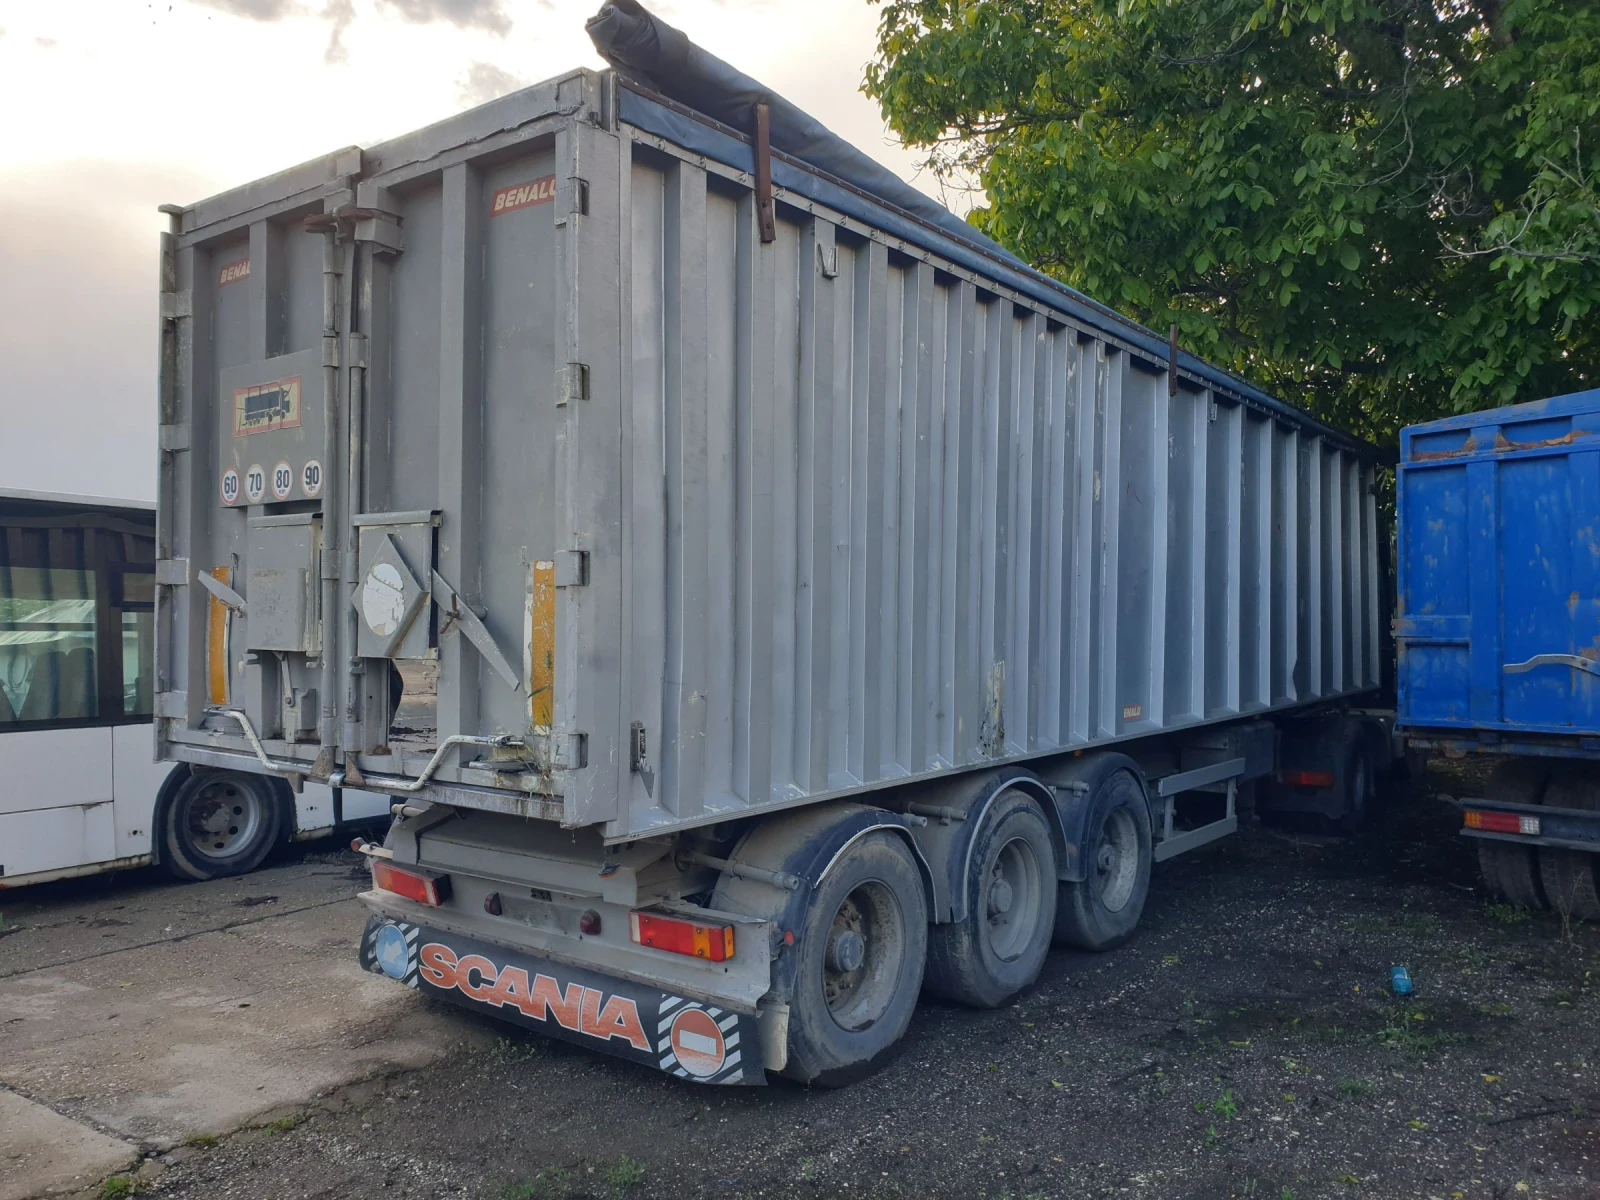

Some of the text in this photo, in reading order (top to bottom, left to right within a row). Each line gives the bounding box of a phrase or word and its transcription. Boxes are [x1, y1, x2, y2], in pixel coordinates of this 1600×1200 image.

[224, 475, 237, 494] 60
[248, 472, 262, 492] 70
[276, 469, 290, 489] 80
[305, 465, 320, 485] 90
[418, 942, 652, 1053] SCANIA
